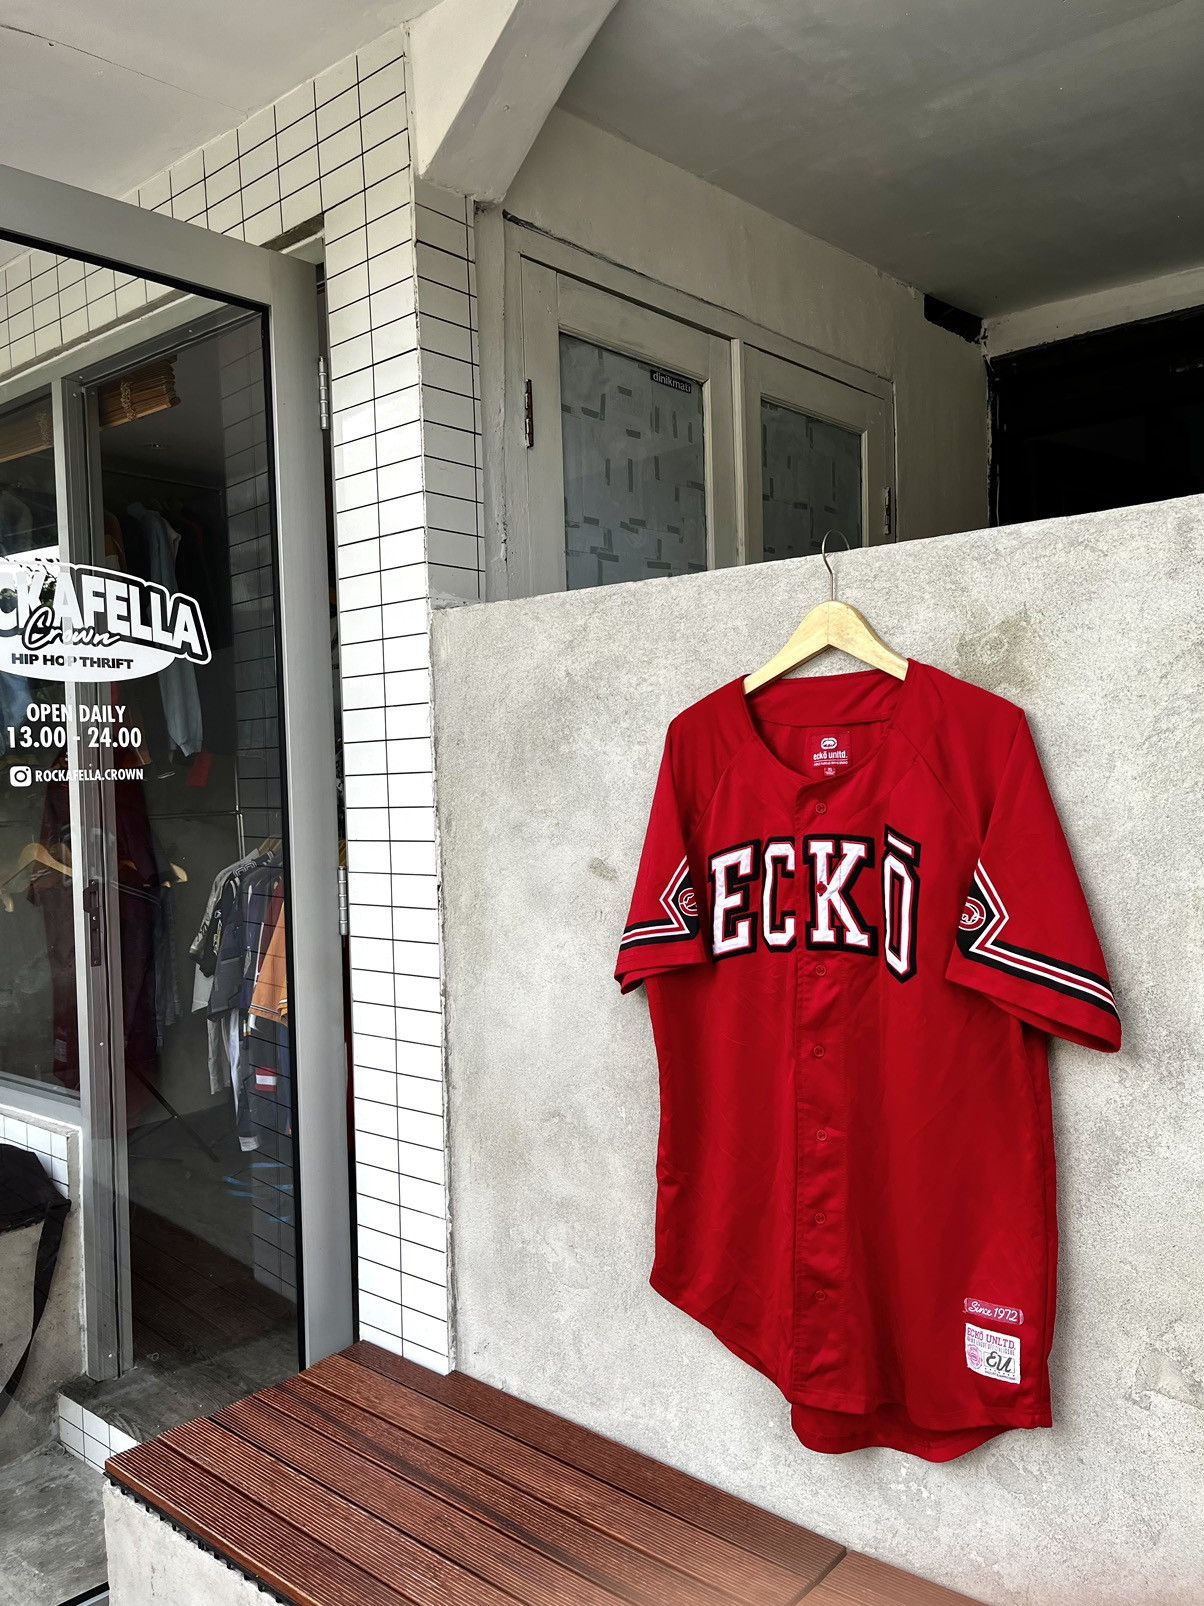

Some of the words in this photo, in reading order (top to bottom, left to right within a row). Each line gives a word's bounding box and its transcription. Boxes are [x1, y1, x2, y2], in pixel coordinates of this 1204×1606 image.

[653, 372, 691, 392] dinikmati
[25, 606, 121, 649] Crown
[11, 653, 39, 665] HIP
[42, 655, 77, 667] HOP
[79, 656, 134, 669] THRIFT
[26, 703, 73, 722] OPEN
[79, 704, 126, 723] DAILY
[7, 726, 66, 748] 13.00
[87, 727, 142, 748] 24.00
[35, 768, 144, 782] ROCKAFELLA.CROWN
[967, 1301, 993, 1317] Since
[993, 1307, 1018, 1322] 1972
